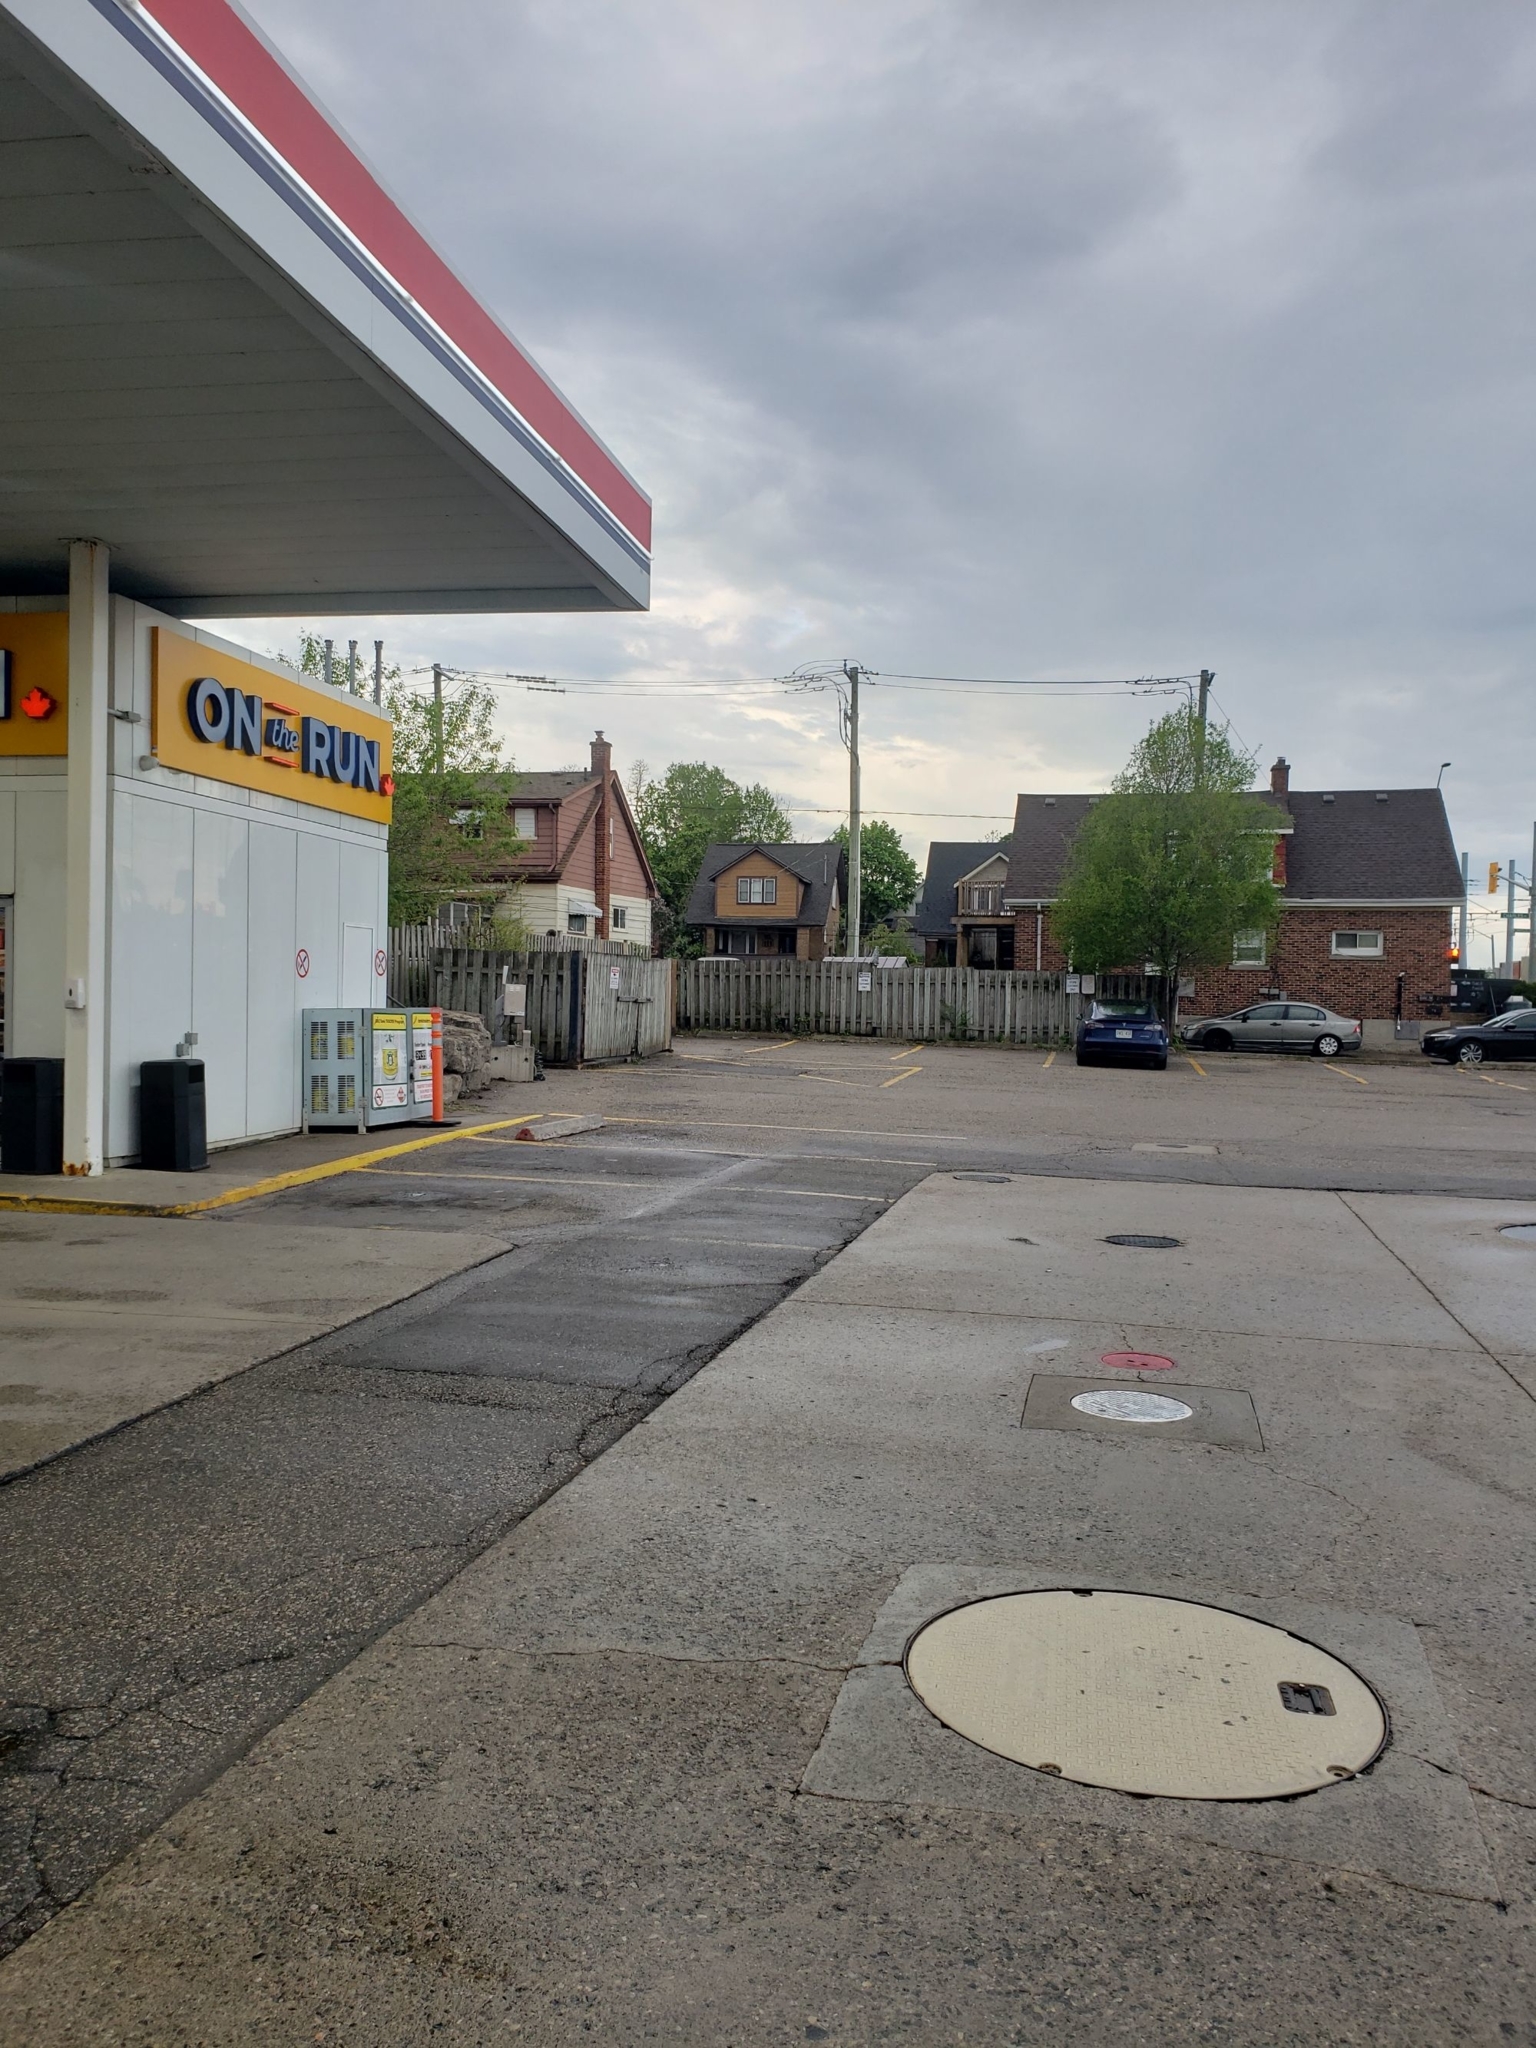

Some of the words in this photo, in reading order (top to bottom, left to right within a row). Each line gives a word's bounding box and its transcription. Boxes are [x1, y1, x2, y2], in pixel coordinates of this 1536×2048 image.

[187, 678, 262, 756] ON
[265, 719, 299, 752] the
[302, 717, 380, 792] RUN
